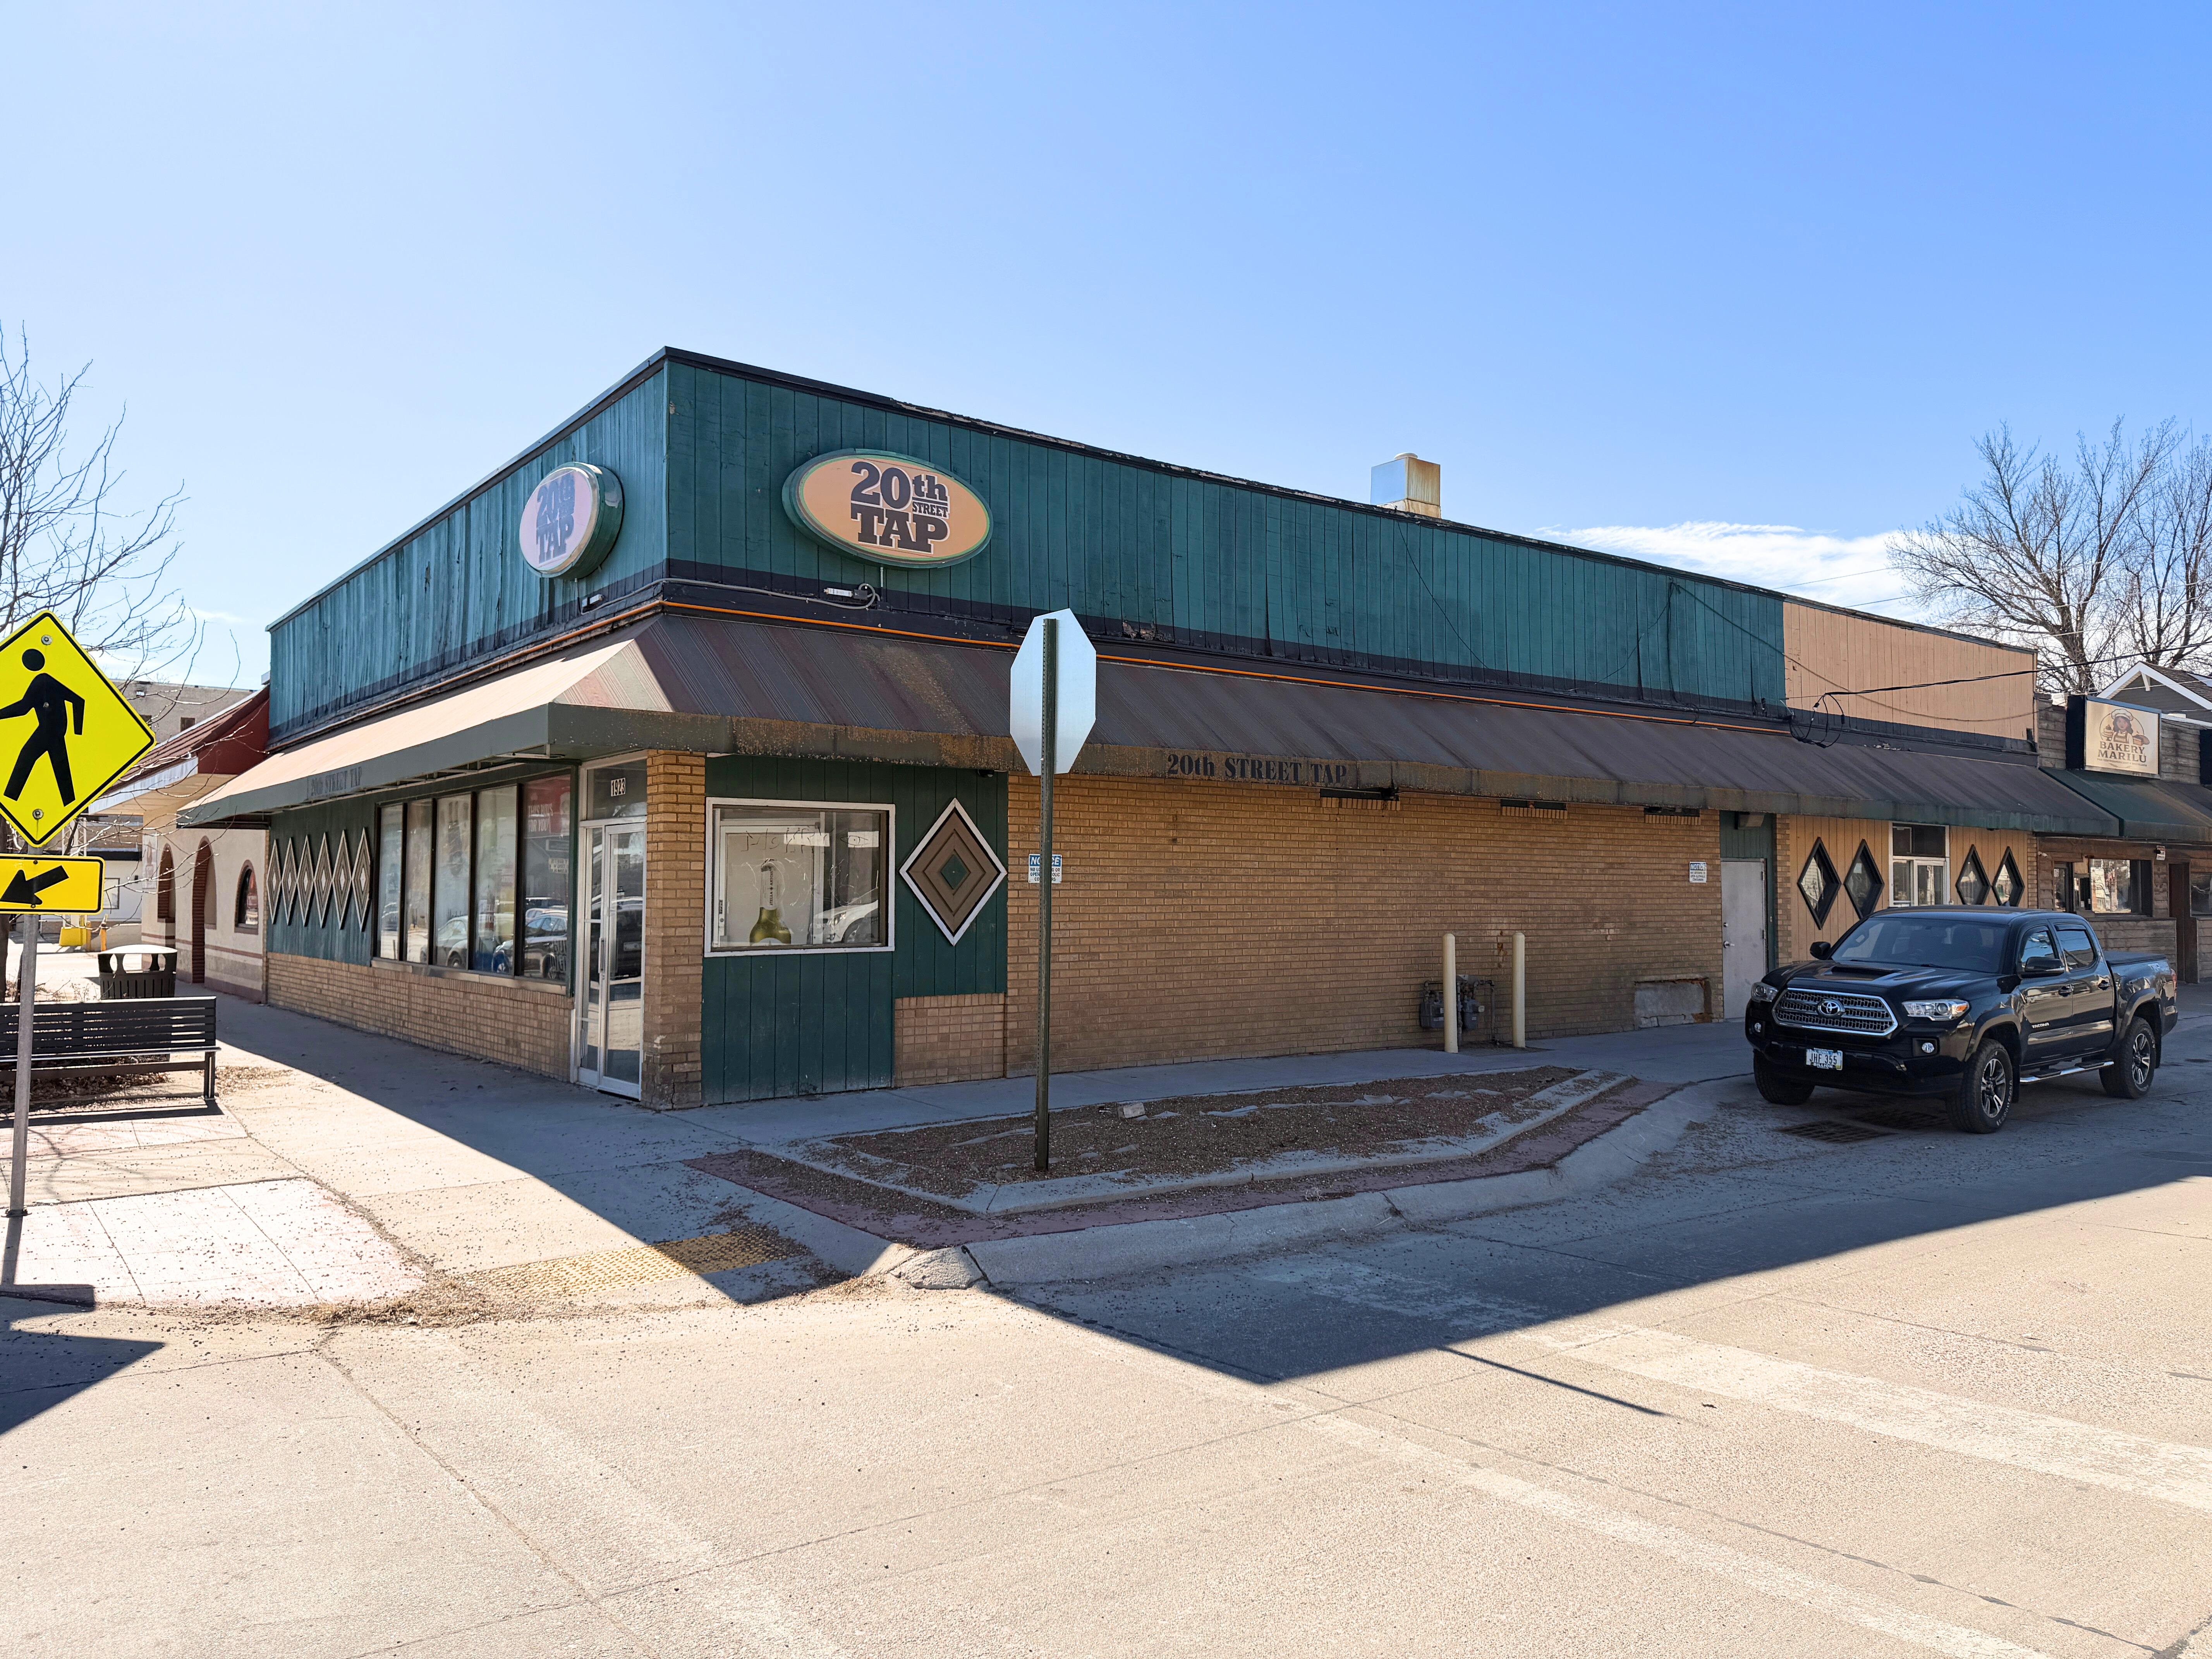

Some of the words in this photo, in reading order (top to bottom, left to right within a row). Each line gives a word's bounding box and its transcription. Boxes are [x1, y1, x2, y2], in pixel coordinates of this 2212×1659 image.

[851, 461, 948, 509] 20th
[912, 501, 949, 518] STREET
[536, 514, 574, 564] TAP
[851, 503, 949, 554] TAP
[2100, 741, 2145, 754] BAKERY
[350, 766, 362, 788] TAP
[1167, 754, 1215, 777] 20th
[1225, 757, 1302, 781] STREET
[1310, 764, 1347, 783] TAP
[612, 778, 625, 796] 1923
[1809, 1053, 1822, 1063] JHF
[1824, 1054, 1837, 1065] 355
